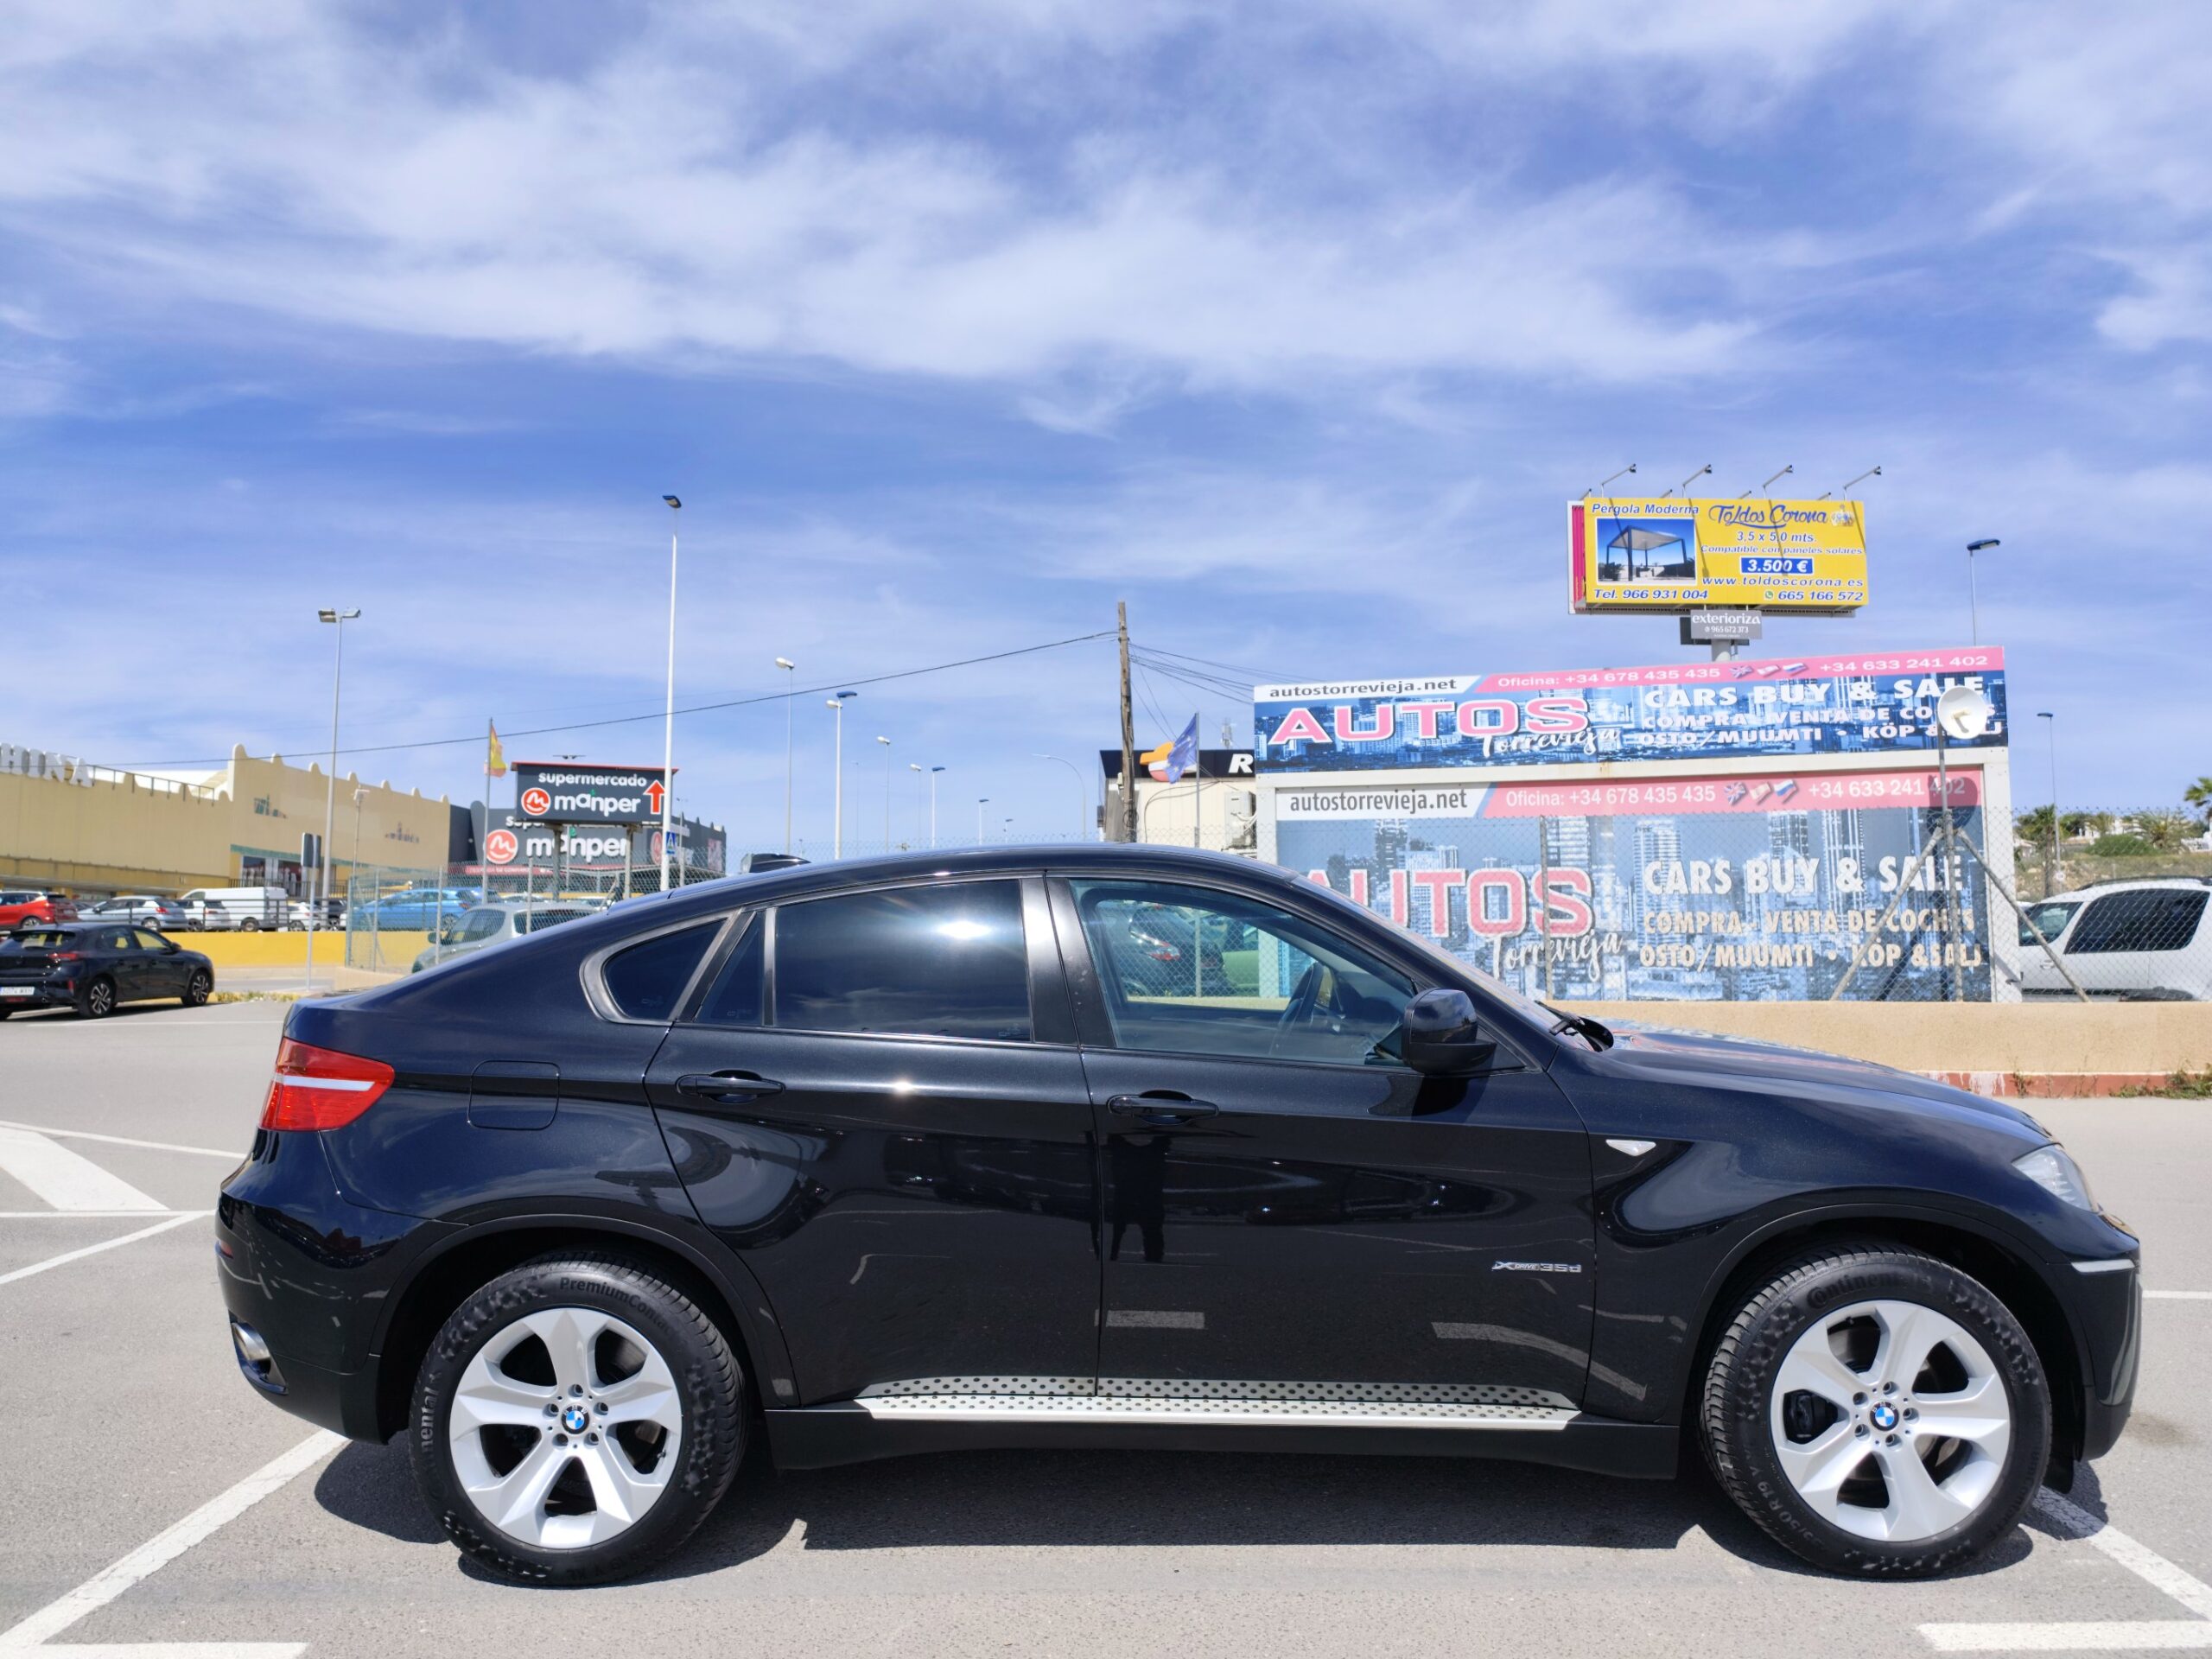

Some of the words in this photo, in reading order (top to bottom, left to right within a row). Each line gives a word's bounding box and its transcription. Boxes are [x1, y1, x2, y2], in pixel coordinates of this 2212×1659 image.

[1645, 504, 1699, 515] Moderna
[1708, 505, 1765, 527] Toldos
[1769, 505, 1827, 524] Corona
[1700, 544, 1758, 554] Compatible
[1783, 546, 1822, 556] paneles
[1826, 546, 1863, 555] solares
[1747, 559, 1793, 573] 3.500
[1796, 560, 1808, 573] €
[1701, 576, 1864, 587] www.toldoscorona.es
[1594, 588, 1618, 599] Tel.
[1623, 588, 1649, 599] 966
[1652, 589, 1677, 599] 931
[1681, 589, 1708, 599] 004
[1778, 590, 1804, 601] 665
[1809, 591, 1834, 601] 166
[1837, 591, 1864, 601] 572
[1692, 613, 1761, 625] exterioriza
[1711, 626, 1724, 634] 965
[1820, 662, 1857, 672] +34
[1862, 660, 1900, 671] 633
[1906, 658, 1944, 669] 241
[1949, 656, 1988, 667] 402
[1269, 677, 1458, 698] autostorrevieja.net
[1497, 676, 1560, 688] Oficina:
[1565, 673, 1599, 683] +34
[1604, 672, 1639, 682] 678
[1644, 671, 1680, 680] 435
[1685, 668, 1721, 677] 435
[1644, 687, 1738, 709] CARS
[1752, 683, 1832, 705] BUY
[1848, 681, 1878, 701] &
[1268, 696, 1590, 746] AUTOS
[1643, 713, 1748, 729] COMPRA
[1860, 707, 1891, 721] DE
[1862, 722, 1916, 740] KÖP
[1480, 727, 1622, 759] Torrevieja
[0, 741, 92, 788] HINA
[537, 772, 647, 787] supermercado
[1808, 781, 1843, 798] +34
[1849, 779, 1885, 797] 633
[1890, 778, 1925, 796] 241
[1929, 777, 1966, 795] 402
[554, 792, 641, 817] manper
[1289, 788, 1468, 814] autostorrevieja.net
[1506, 790, 1565, 808] Oficina:
[1569, 788, 1601, 805] +34
[1606, 787, 1639, 804] 678
[1643, 785, 1677, 804] 435
[1682, 785, 1715, 803] 435
[1643, 859, 1732, 895] CARS
[1746, 857, 1821, 894] BUY
[1835, 856, 1865, 893] &
[1878, 855, 1963, 893] SALE
[1643, 911, 1743, 935] COMPRA
[1764, 909, 1839, 934] VENTA
[1847, 909, 1878, 933] DE
[1486, 928, 1624, 982] Torrevieja
